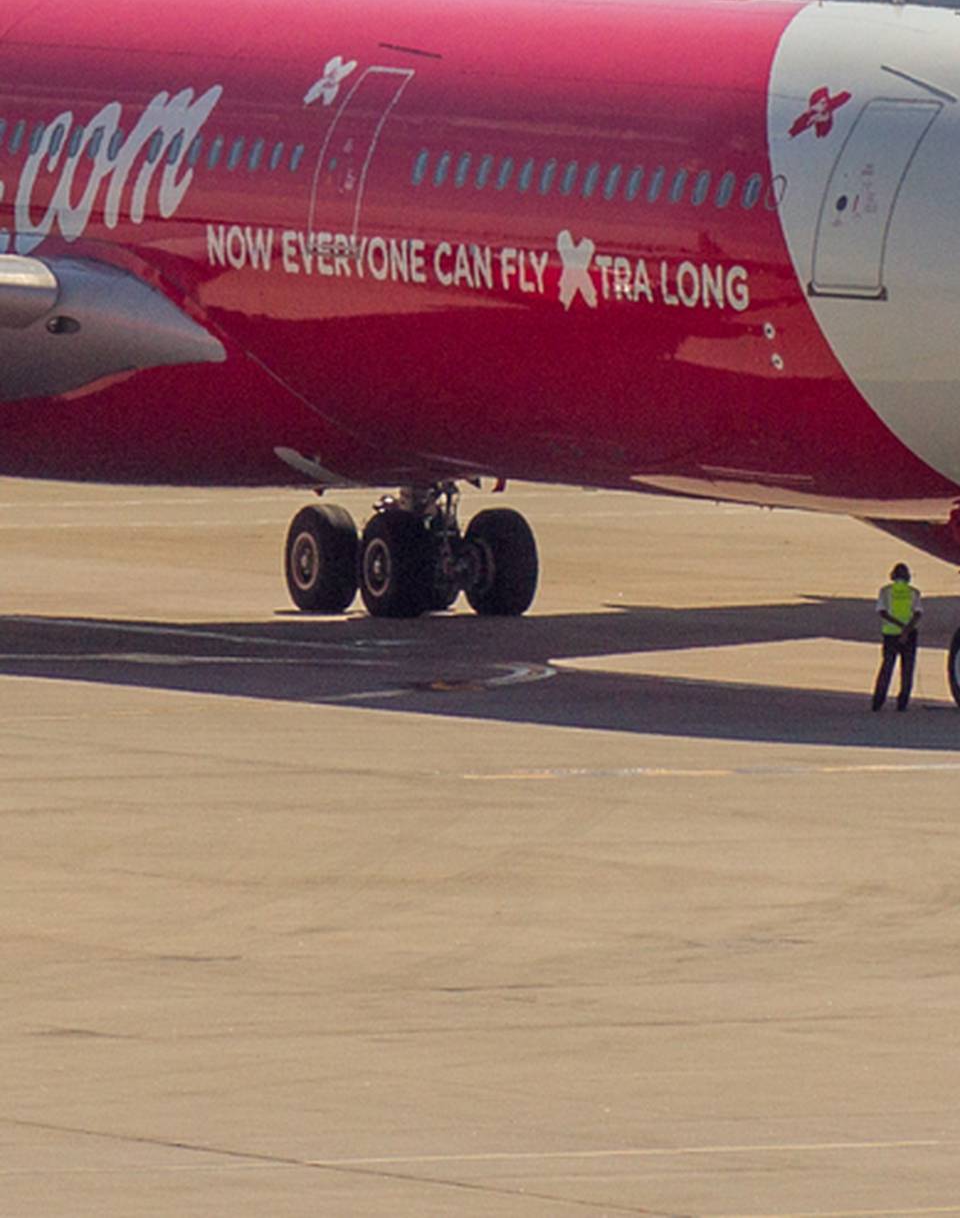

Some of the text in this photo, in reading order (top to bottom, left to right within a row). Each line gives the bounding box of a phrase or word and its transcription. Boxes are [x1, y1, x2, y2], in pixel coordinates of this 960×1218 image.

[206, 223, 274, 272] NOW
[281, 229, 427, 283] EVERYONE
[433, 241, 492, 289] CAN
[501, 247, 548, 294] FLY
[660, 260, 750, 311] LONG
